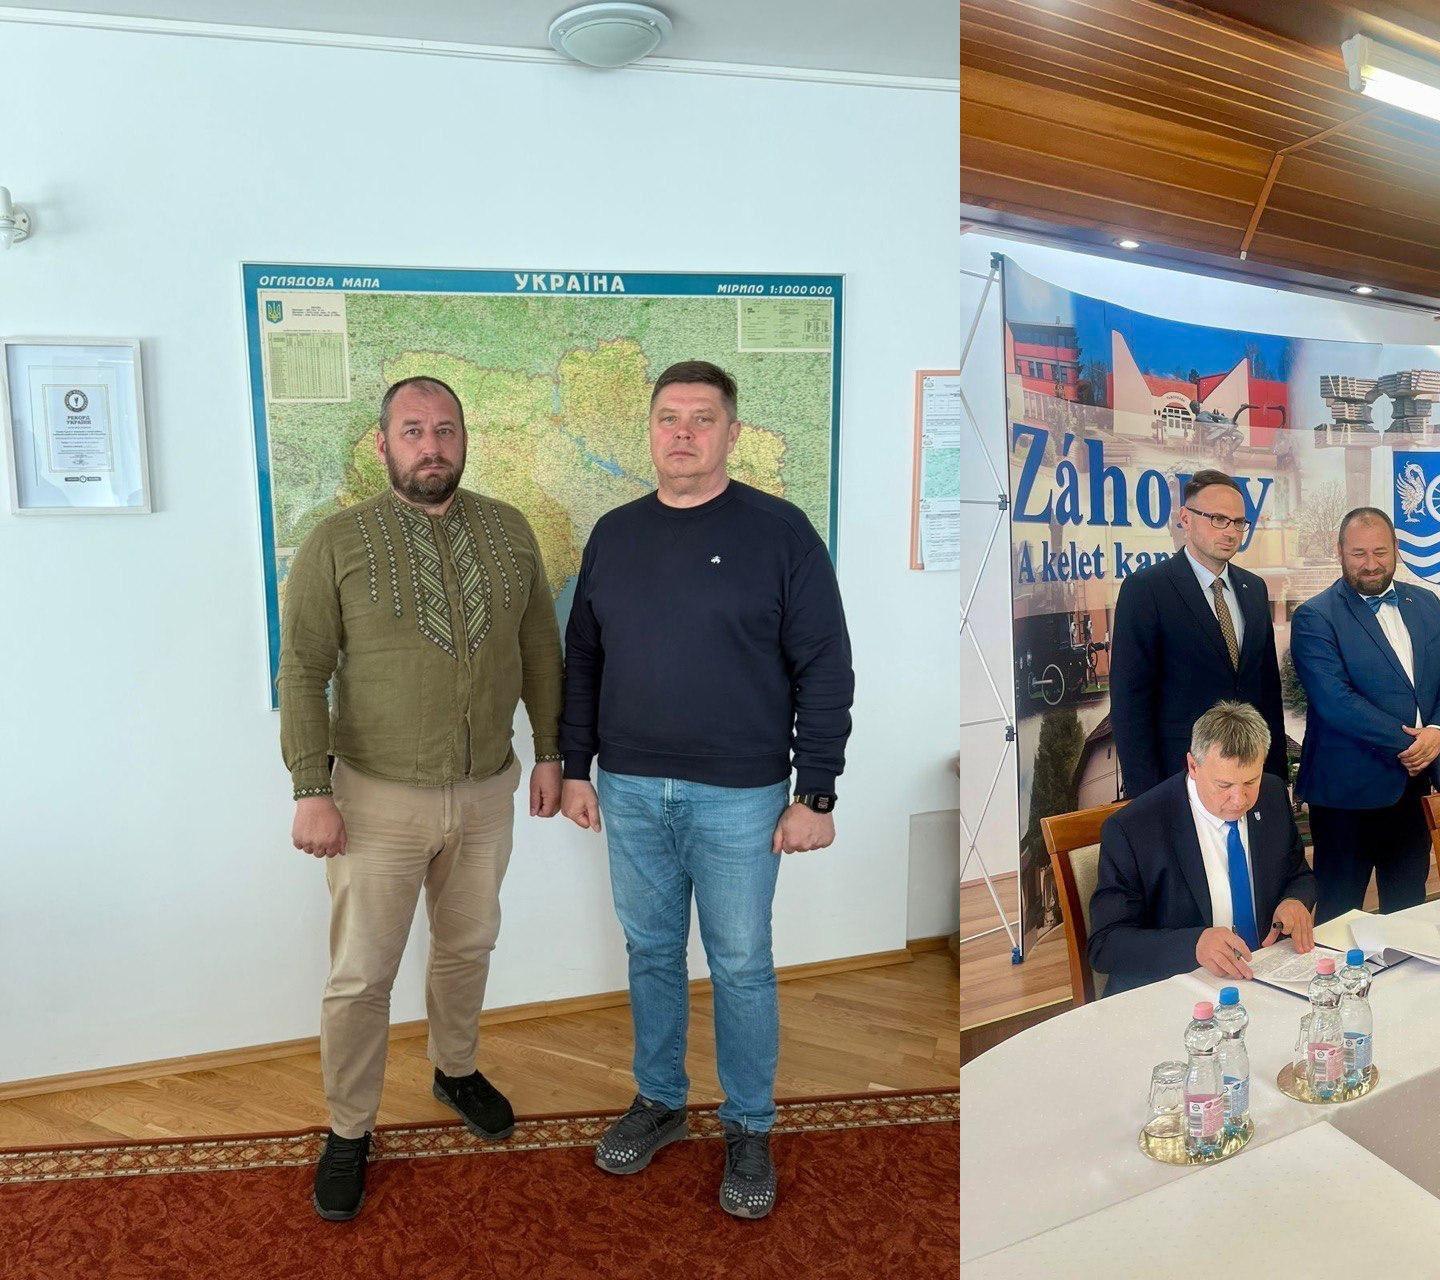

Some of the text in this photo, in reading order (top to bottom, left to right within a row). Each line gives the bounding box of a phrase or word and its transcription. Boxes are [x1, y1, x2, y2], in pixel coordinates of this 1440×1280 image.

[259, 275, 380, 288] ОГЛЯДОВА МАПА
[514, 272, 625, 292] УКРАЇНА
[717, 284, 764, 294] МІРИЛО
[1012, 422, 1274, 553] Záhoy
[1018, 541, 1036, 583] A
[1042, 540, 1105, 582] kelet
